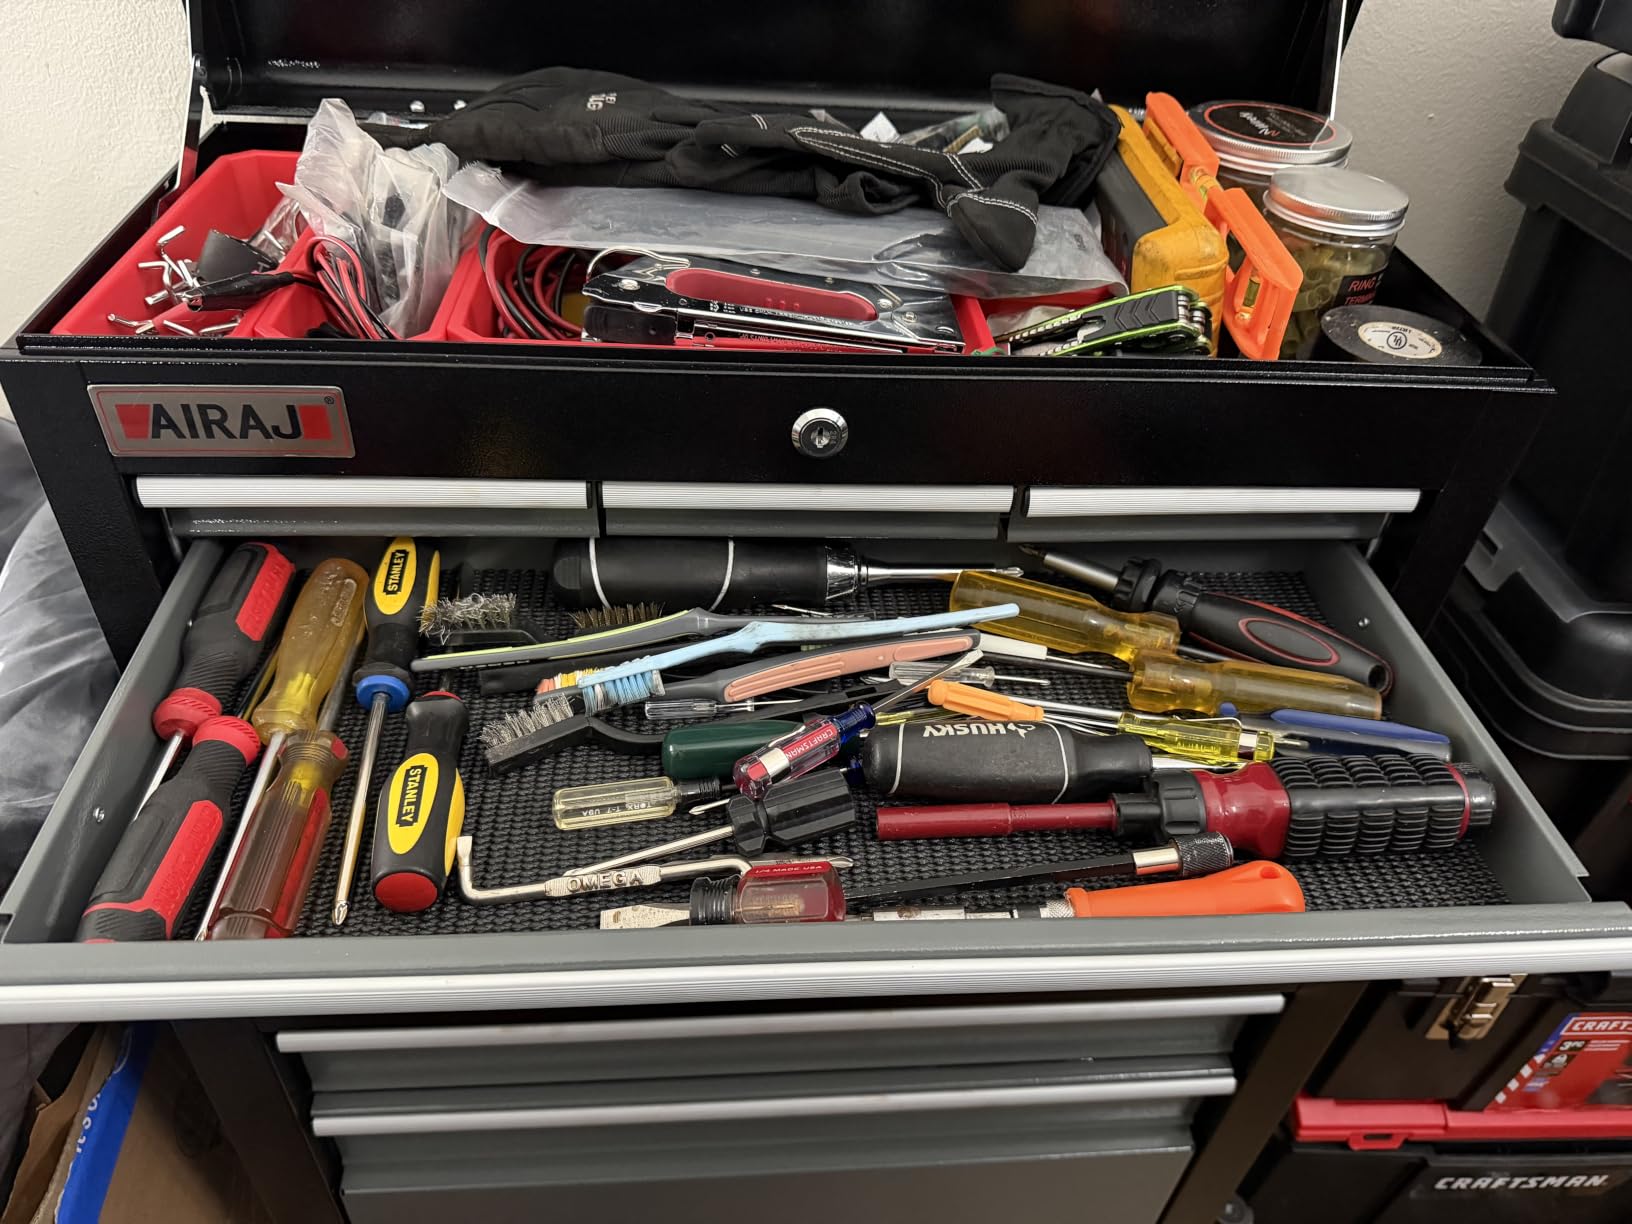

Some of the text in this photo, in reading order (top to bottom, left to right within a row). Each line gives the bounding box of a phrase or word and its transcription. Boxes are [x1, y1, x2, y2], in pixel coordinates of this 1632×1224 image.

[151, 403, 303, 440] AIRAJ
[386, 551, 406, 592] STANLEY
[784, 728, 835, 761] CRAFTSMAN
[922, 722, 1007, 738] HUSKY
[400, 767, 424, 823] STANLEY
[566, 870, 644, 893] OMEGA
[1434, 1175, 1608, 1189] CRAFTSMAN
